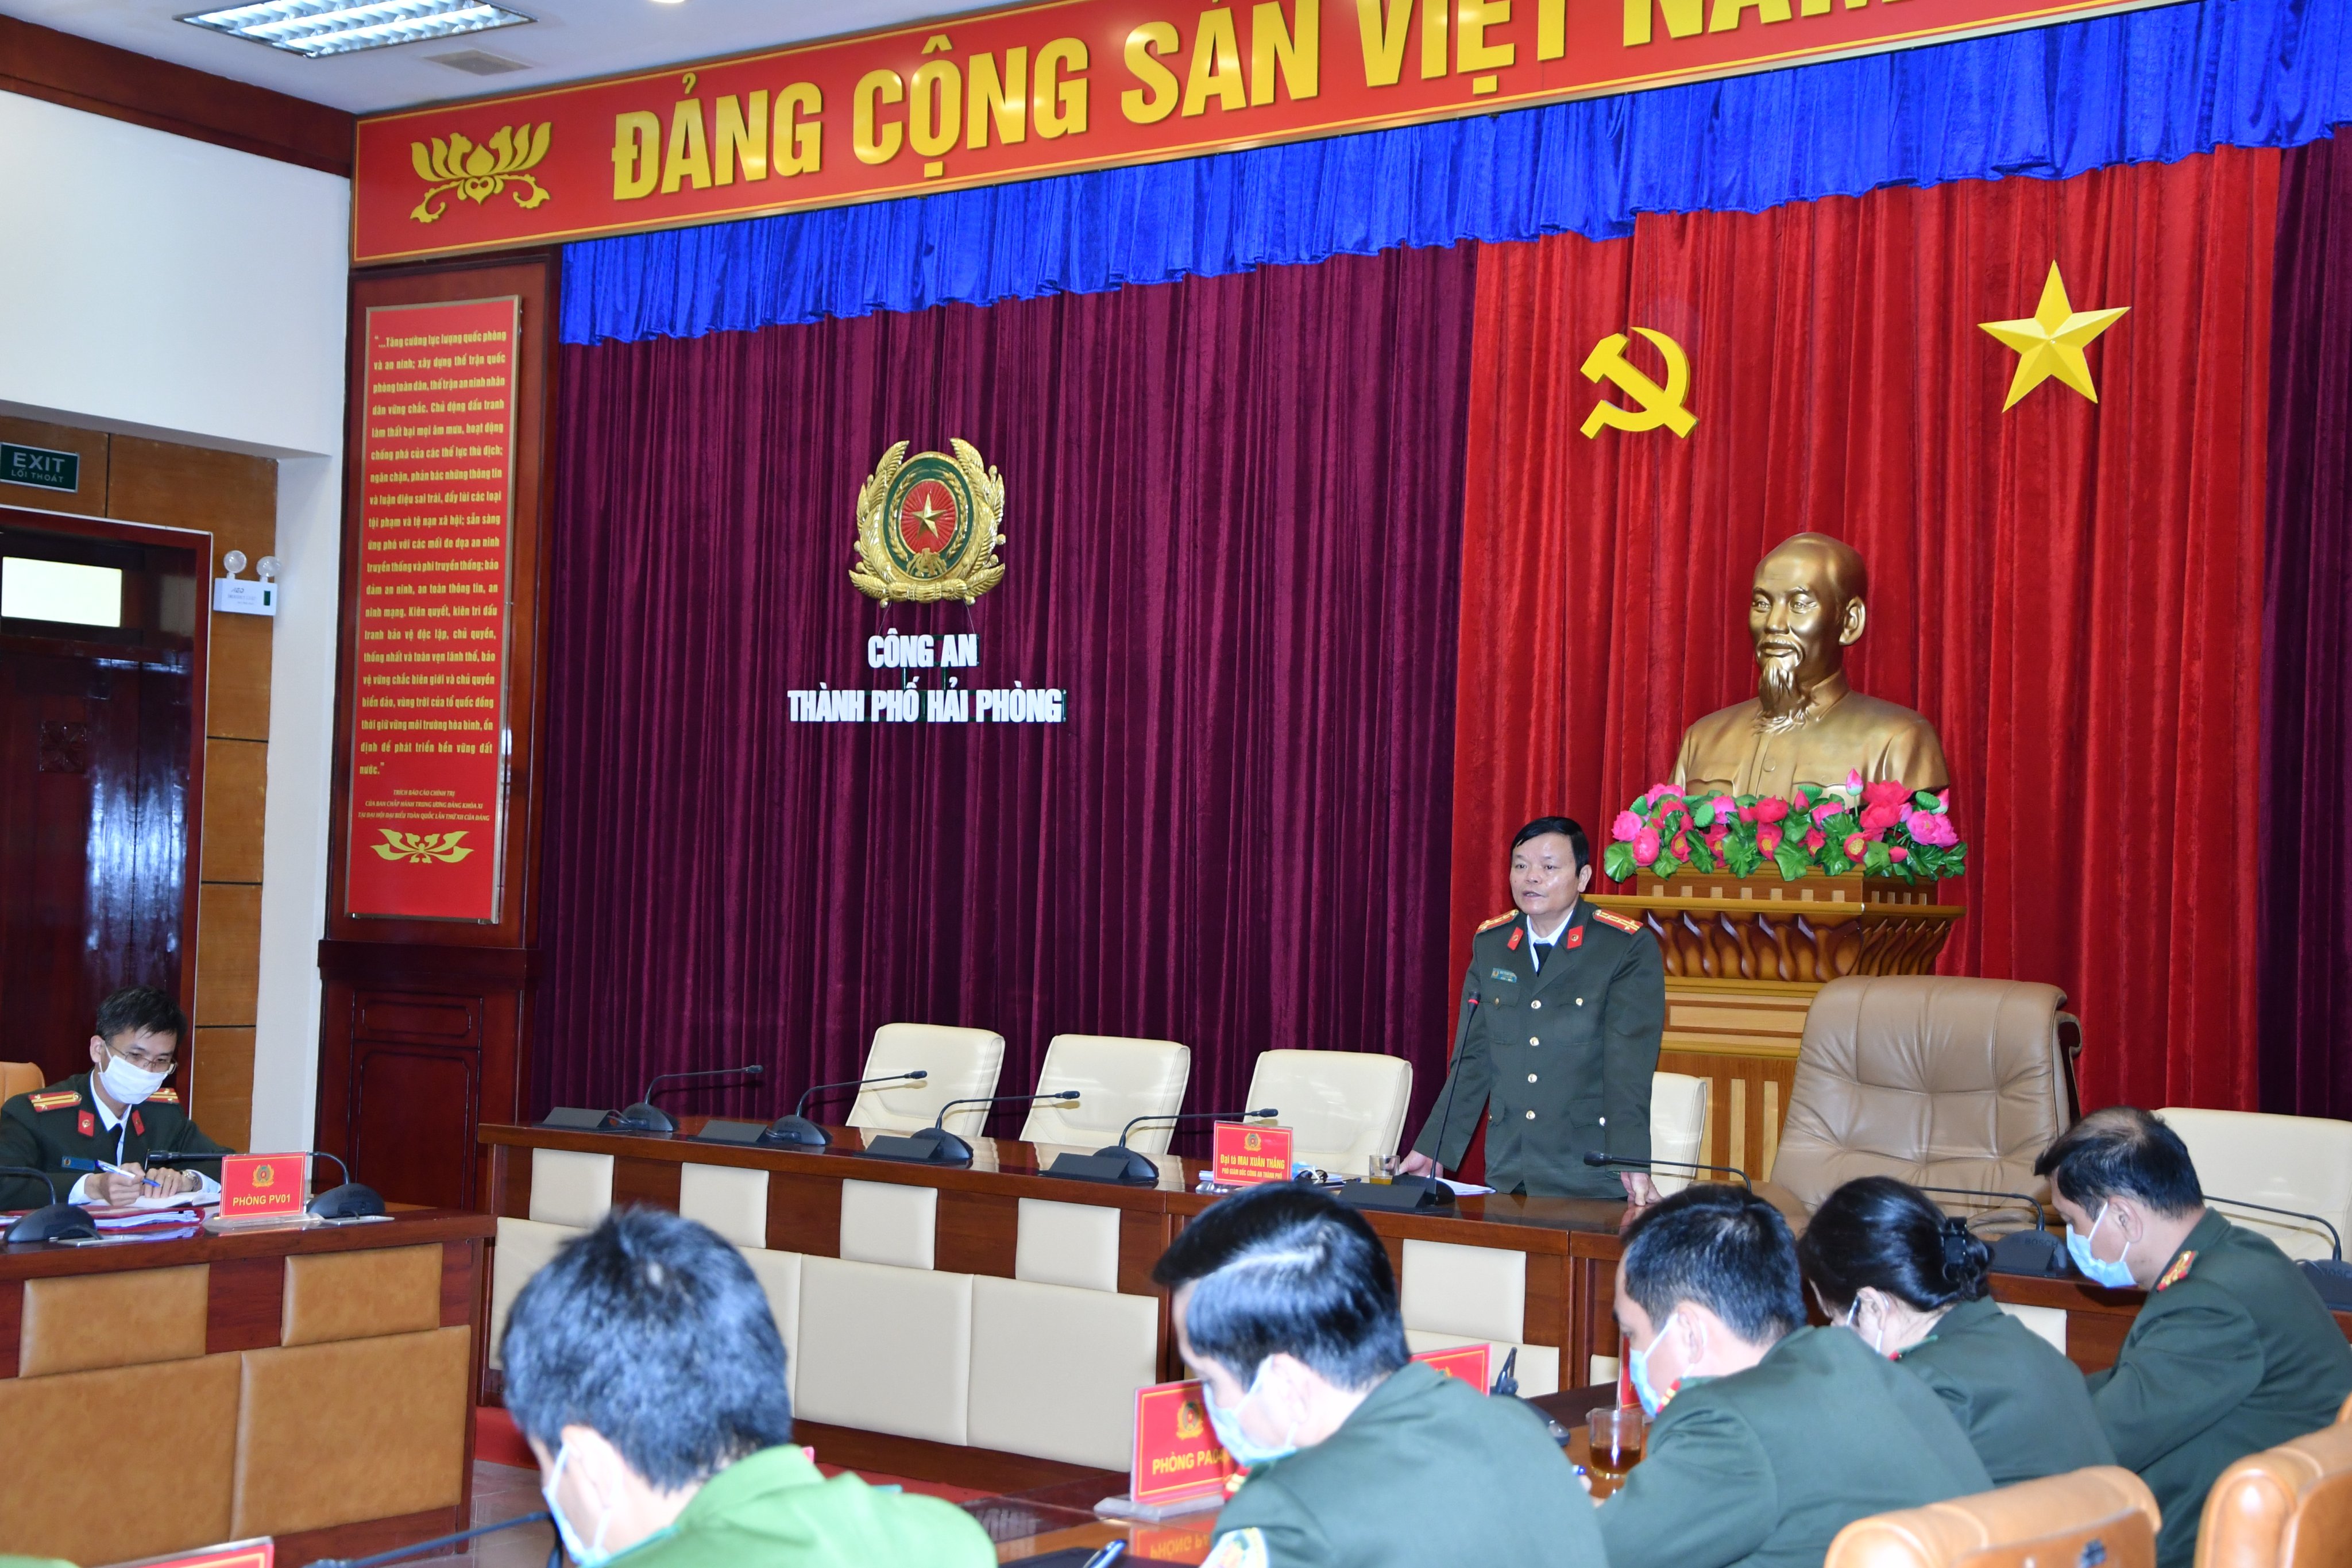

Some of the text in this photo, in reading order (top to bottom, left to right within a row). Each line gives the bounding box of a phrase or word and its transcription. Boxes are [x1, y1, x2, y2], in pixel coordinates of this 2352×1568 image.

[612, 73, 822, 200] ĐẢNG
[853, 36, 1088, 178] CỘNG
[1121, 0, 1319, 124] SẢN
[13, 451, 65, 473] EXIT
[11, 468, 64, 483] LỐI THOÁT
[868, 628, 978, 668] CÔNG AN
[787, 676, 1063, 723] THÀNH PHỐ HẢI PHÒNG
[1238, 1156, 1248, 1165] MAI
[1250, 1156, 1265, 1167] XUÂN
[233, 1194, 290, 1207] PHÒNG PV01
[2025, 1237, 2059, 1248] BOSCH
[1152, 1451, 1195, 1475] PHÒNG
